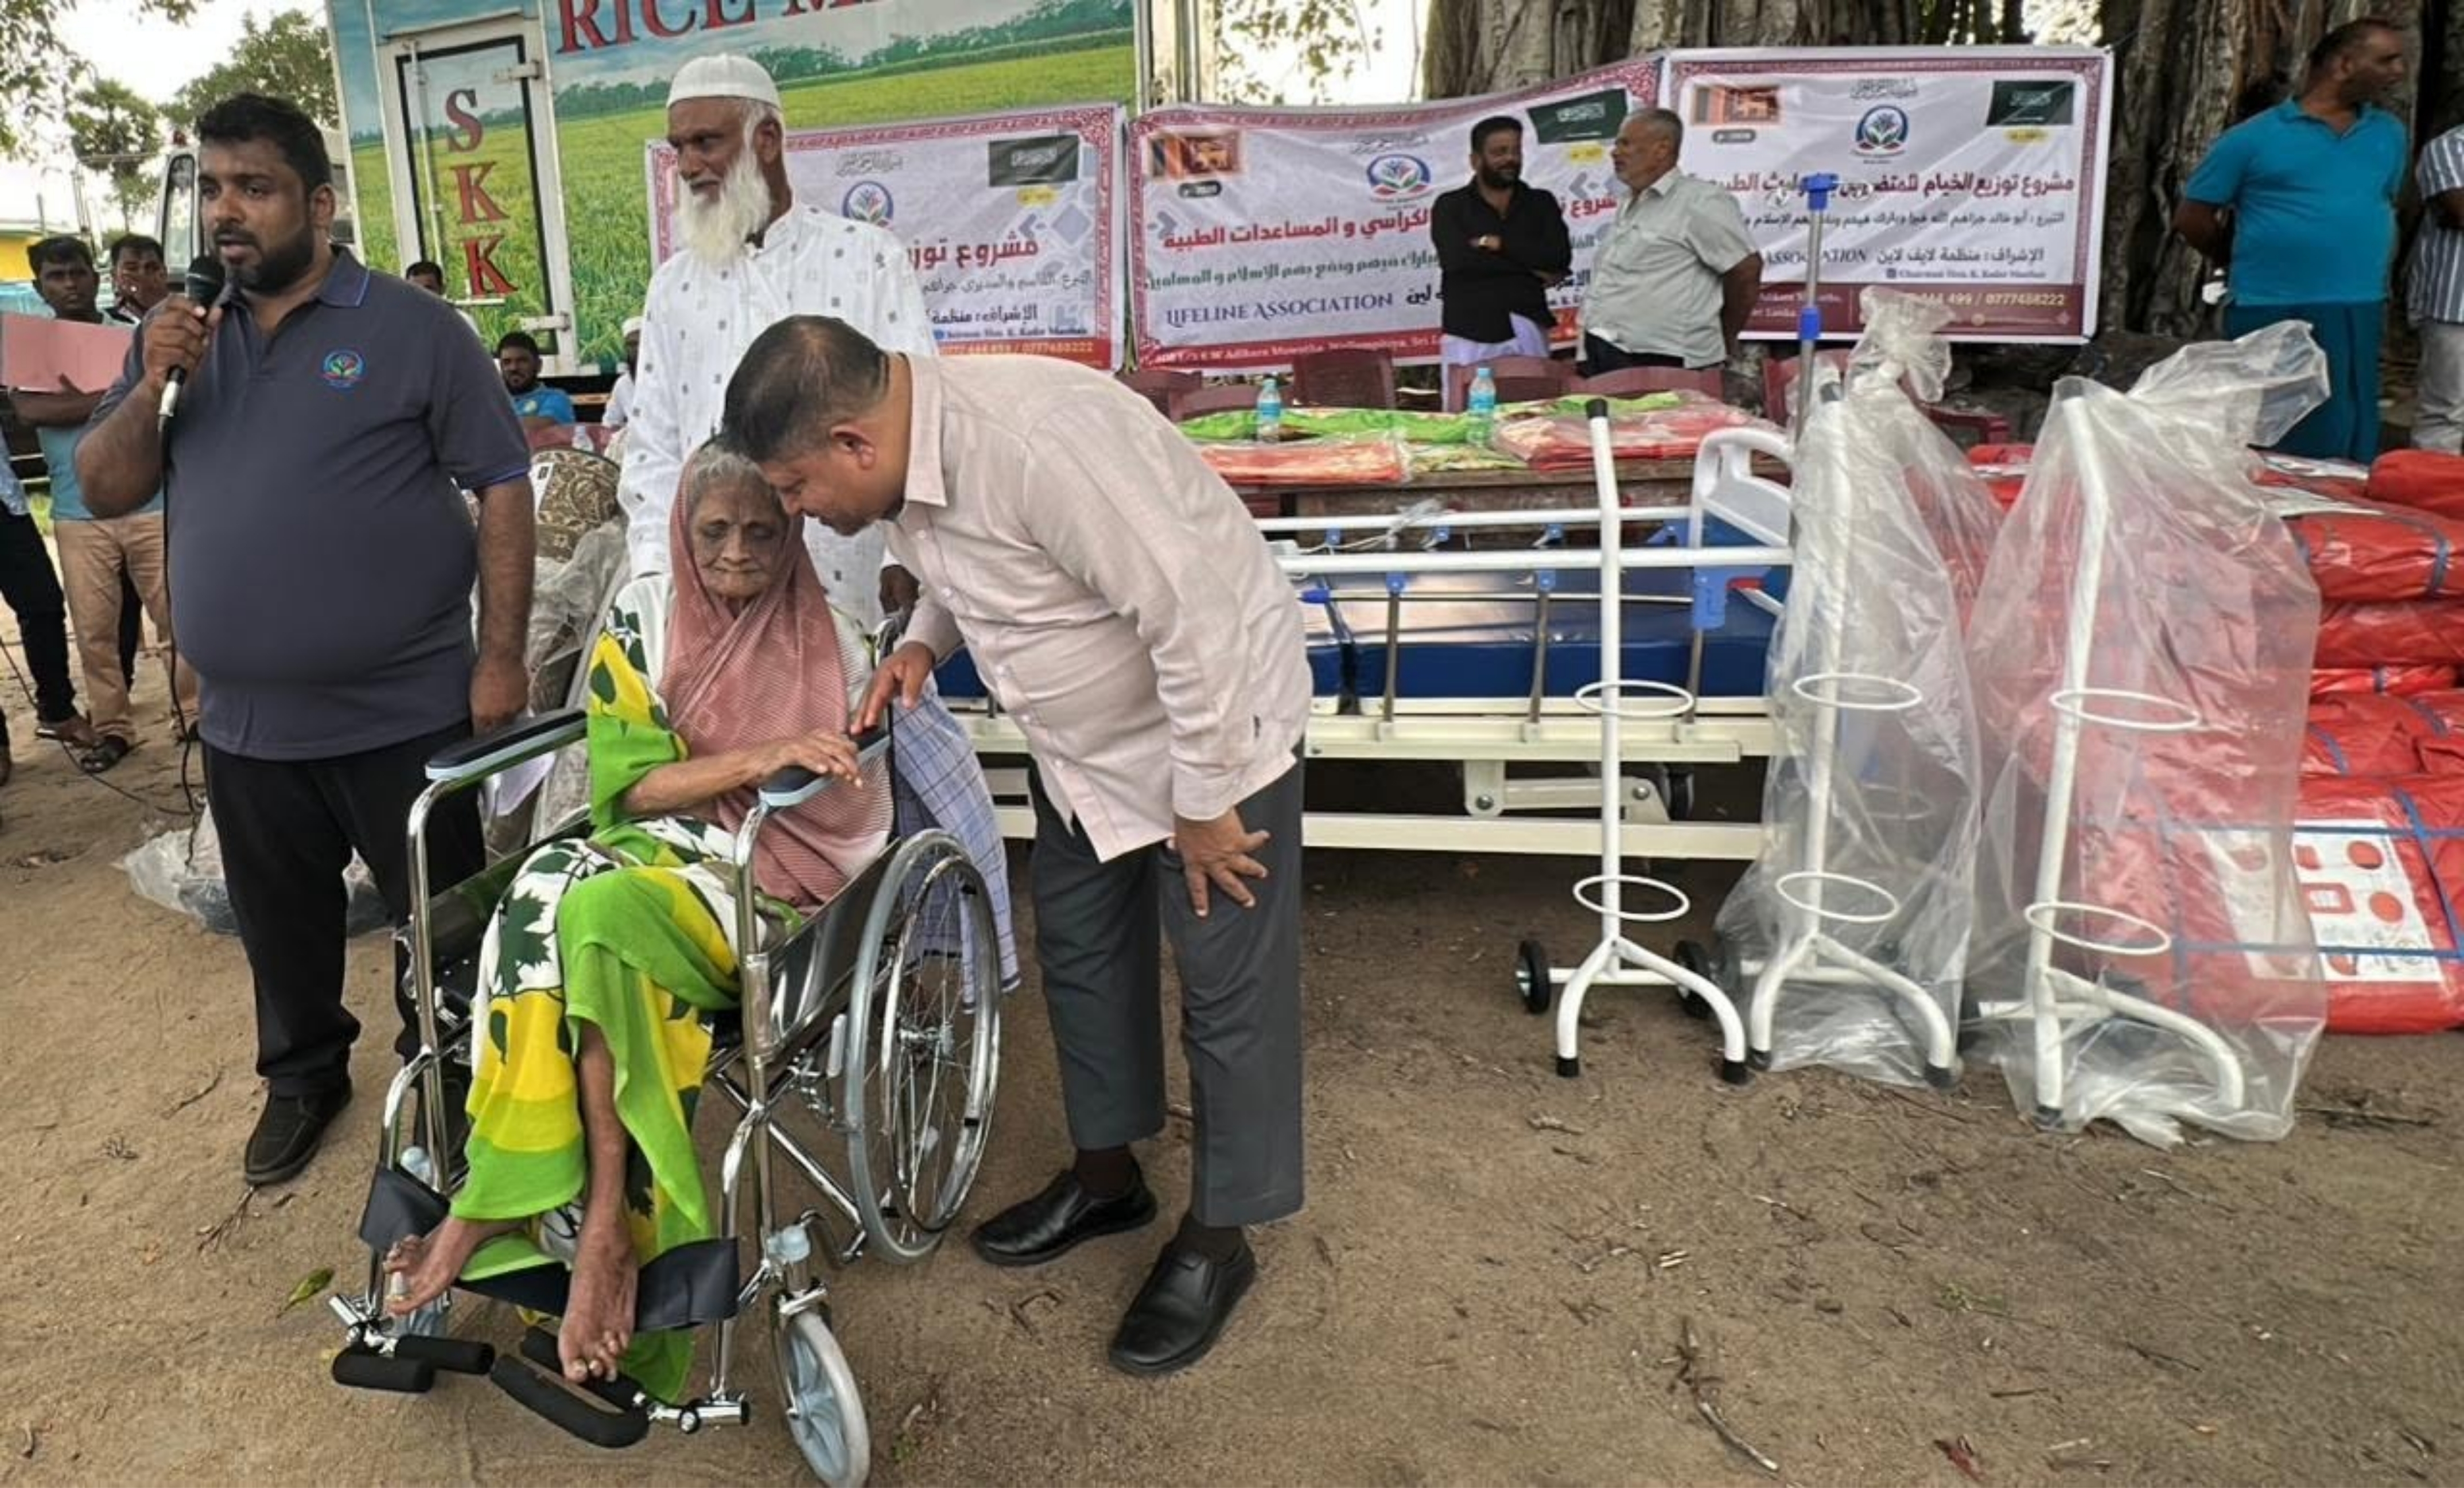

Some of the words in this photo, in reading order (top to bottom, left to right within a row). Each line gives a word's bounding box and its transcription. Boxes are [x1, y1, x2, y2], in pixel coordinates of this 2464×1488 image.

[1925, 172, 1973, 197] الخيام
[1974, 173, 2019, 197] توزيع
[2021, 171, 2074, 197] مشروع
[1230, 216, 1339, 243] المساعدات
[1361, 207, 1428, 239] لكراسي
[955, 231, 1038, 268] مشروع
[1164, 226, 1226, 249] الطبية
[1166, 303, 1250, 328] LIFELINE
[1254, 293, 1393, 321] ASSOCIATION
